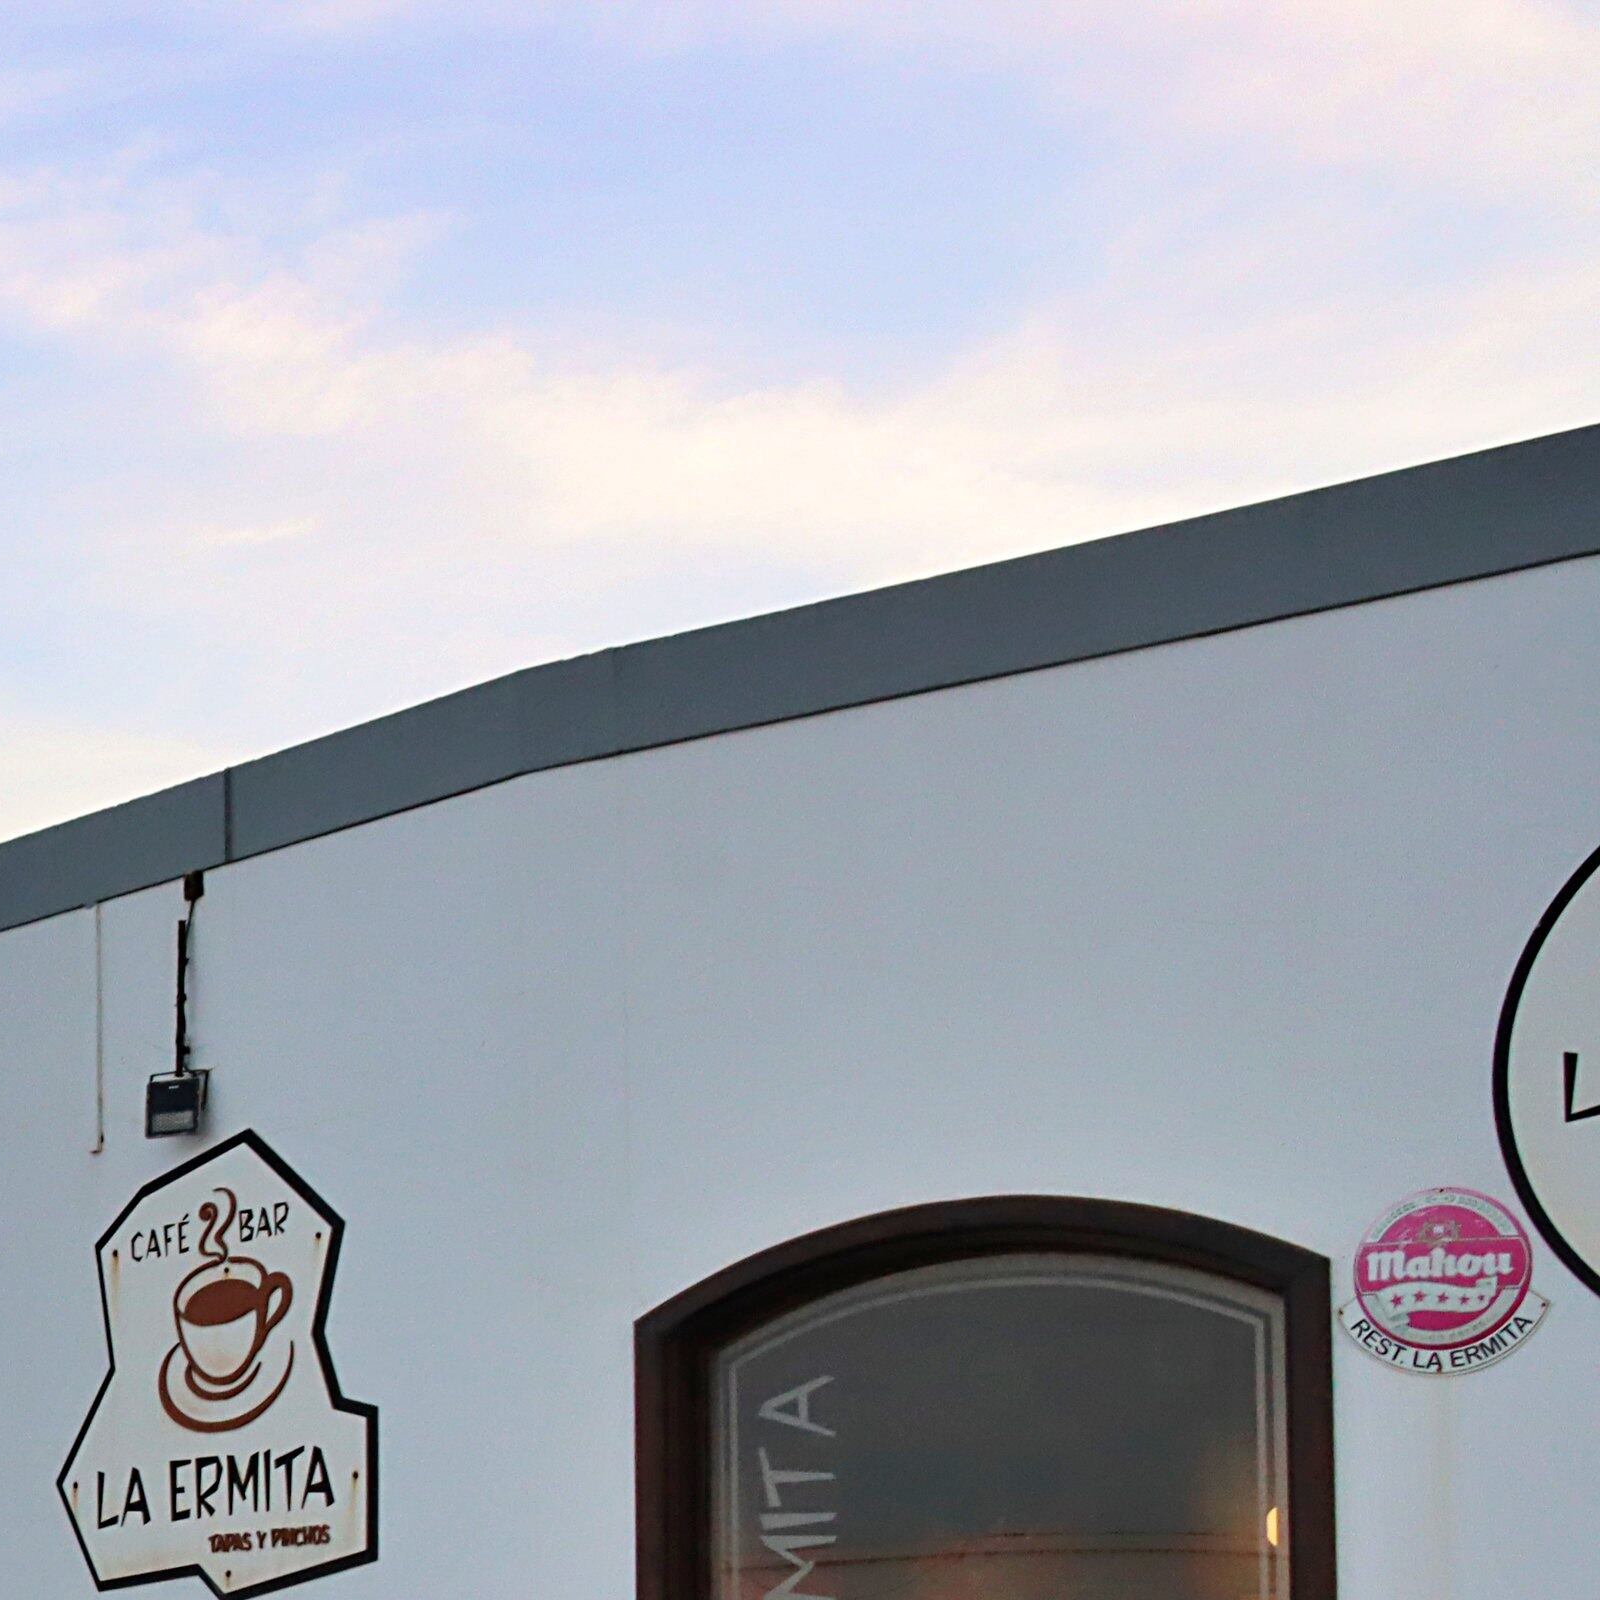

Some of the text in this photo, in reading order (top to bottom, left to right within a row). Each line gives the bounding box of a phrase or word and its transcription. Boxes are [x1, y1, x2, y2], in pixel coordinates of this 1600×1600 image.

[131, 1202, 289, 1262] CAFÉ BAR
[1367, 1247, 1513, 1282] Mahou
[1350, 1315, 1533, 1371] REST. LA ERMITA
[97, 1445, 336, 1529] LA ERMITA
[208, 1524, 331, 1553] TAPAS Y PINCHOS
